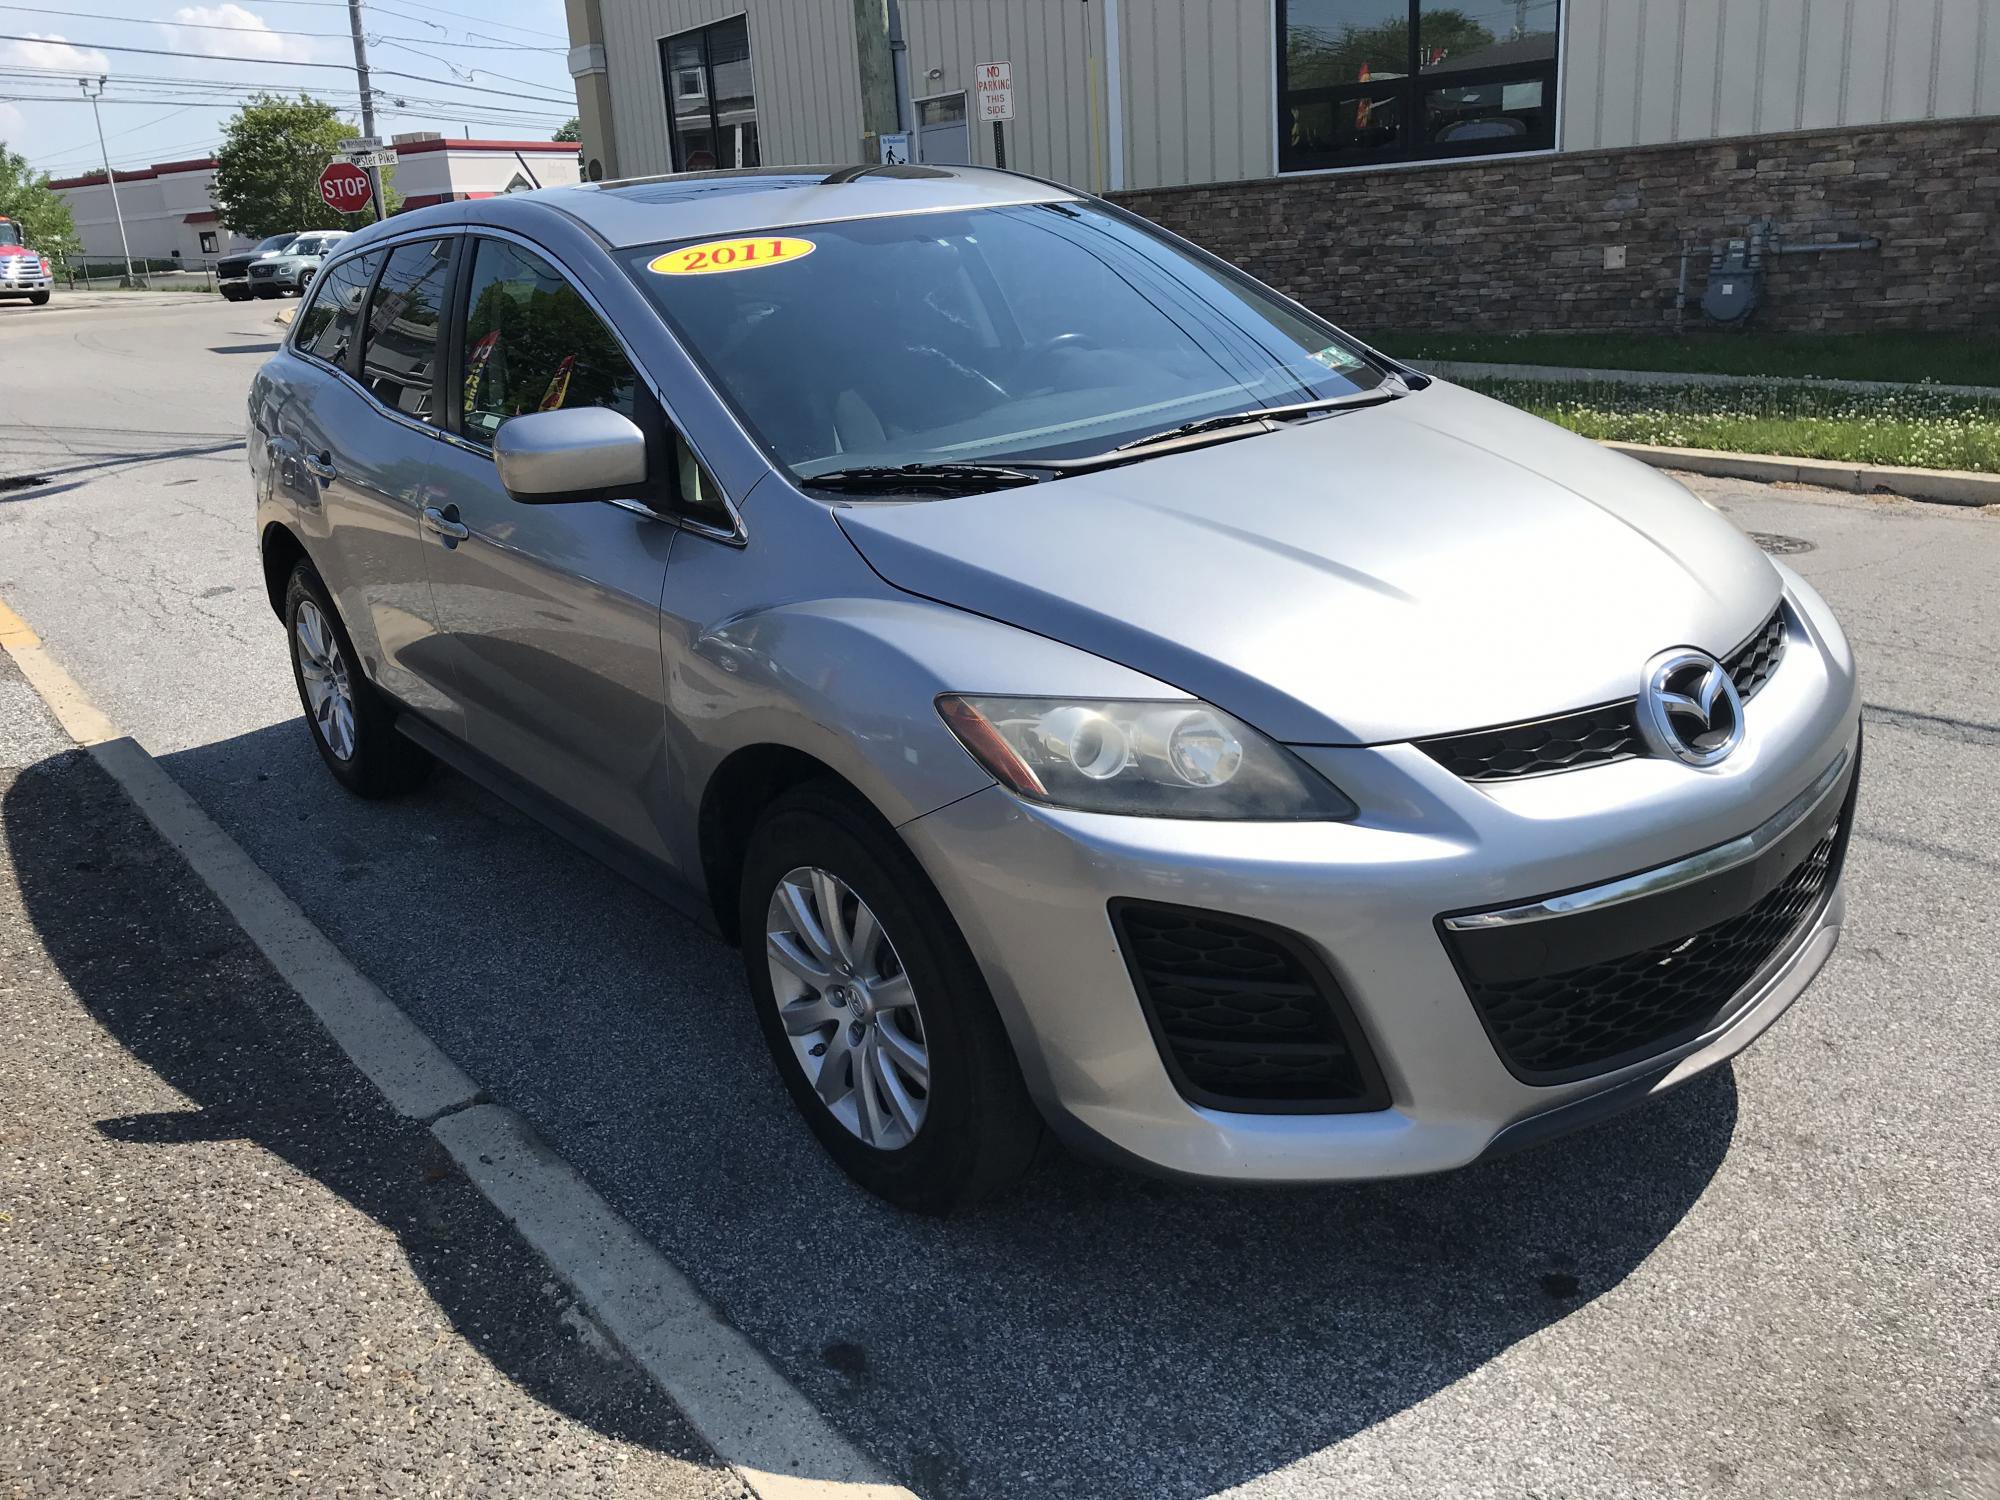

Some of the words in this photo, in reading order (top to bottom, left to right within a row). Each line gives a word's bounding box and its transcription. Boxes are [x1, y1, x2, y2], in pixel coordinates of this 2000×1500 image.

[986, 66, 1000, 78] NO
[978, 79, 1010, 92] PARKING
[986, 94, 1005, 104] THIS
[986, 104, 1006, 115] SIDE
[346, 154, 375, 166] Chester
[378, 152, 395, 164] Pike
[323, 177, 367, 198] STOP
[682, 240, 788, 271] 2011
